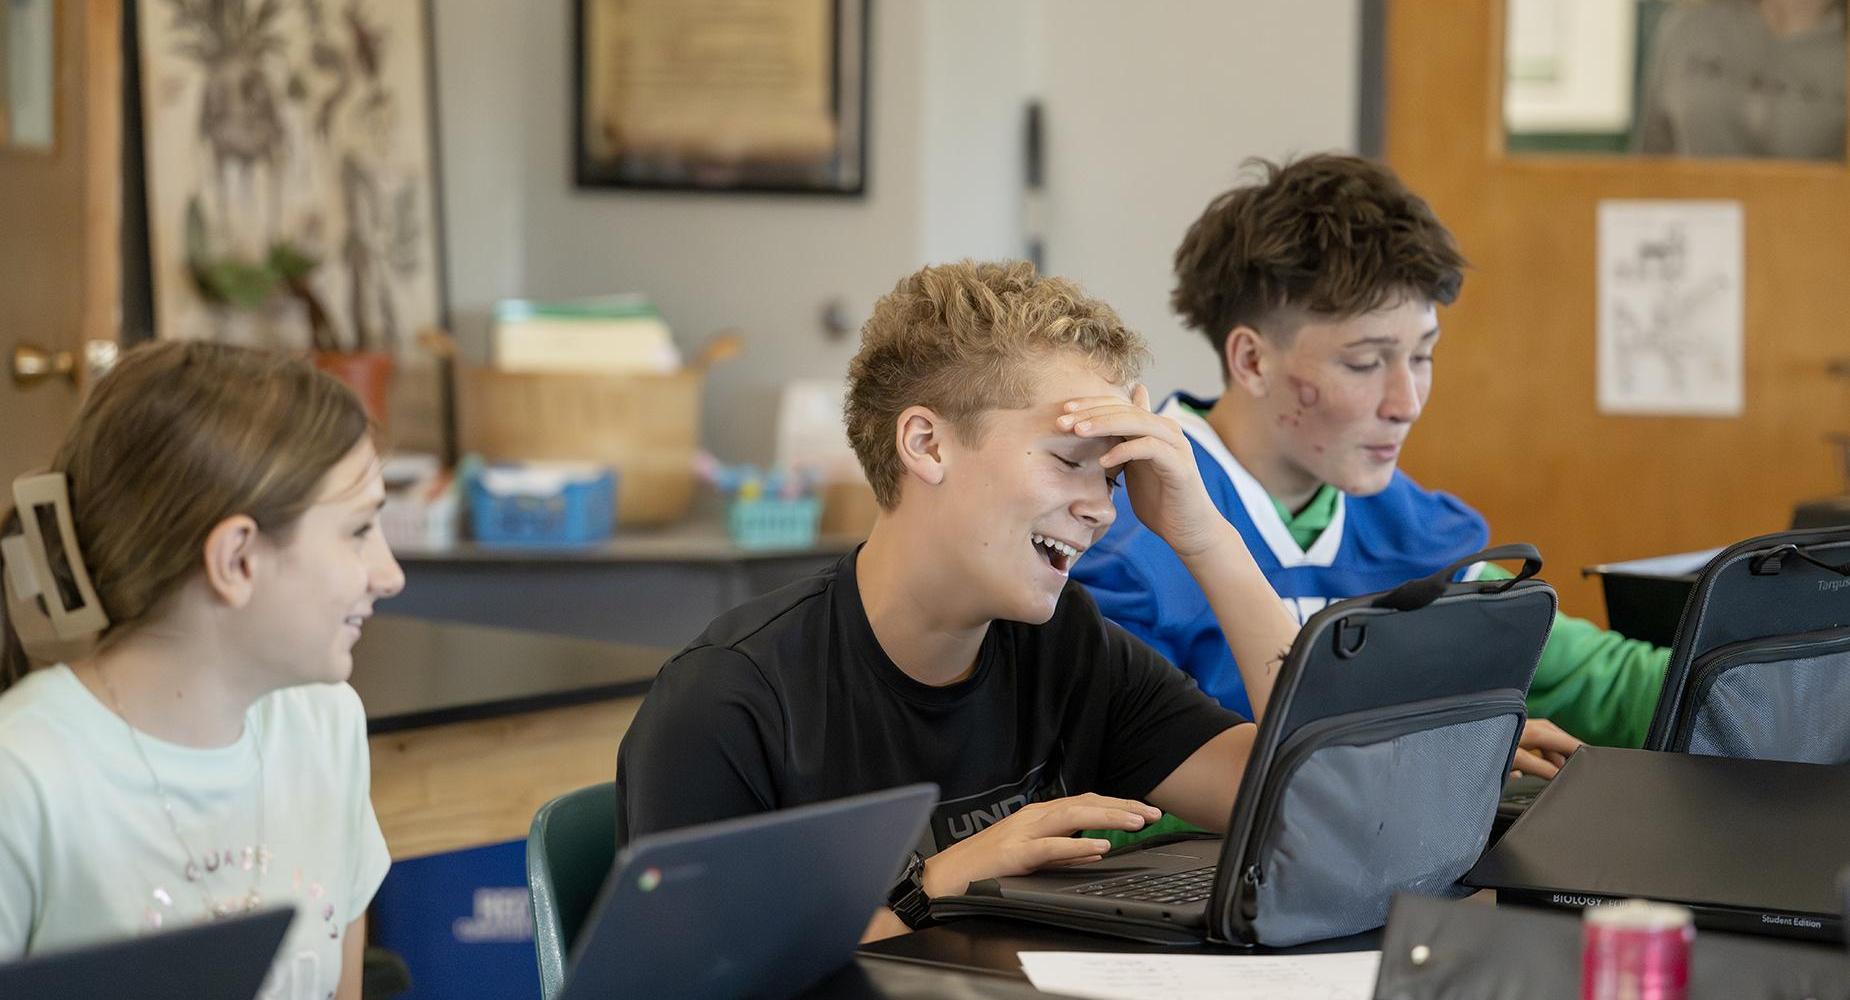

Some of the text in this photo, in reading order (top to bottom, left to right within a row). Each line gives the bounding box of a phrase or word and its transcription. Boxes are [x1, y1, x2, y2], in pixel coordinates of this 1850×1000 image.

[1552, 893, 1602, 907] BIOLOGY
[1761, 914, 1822, 928] Student Edition
